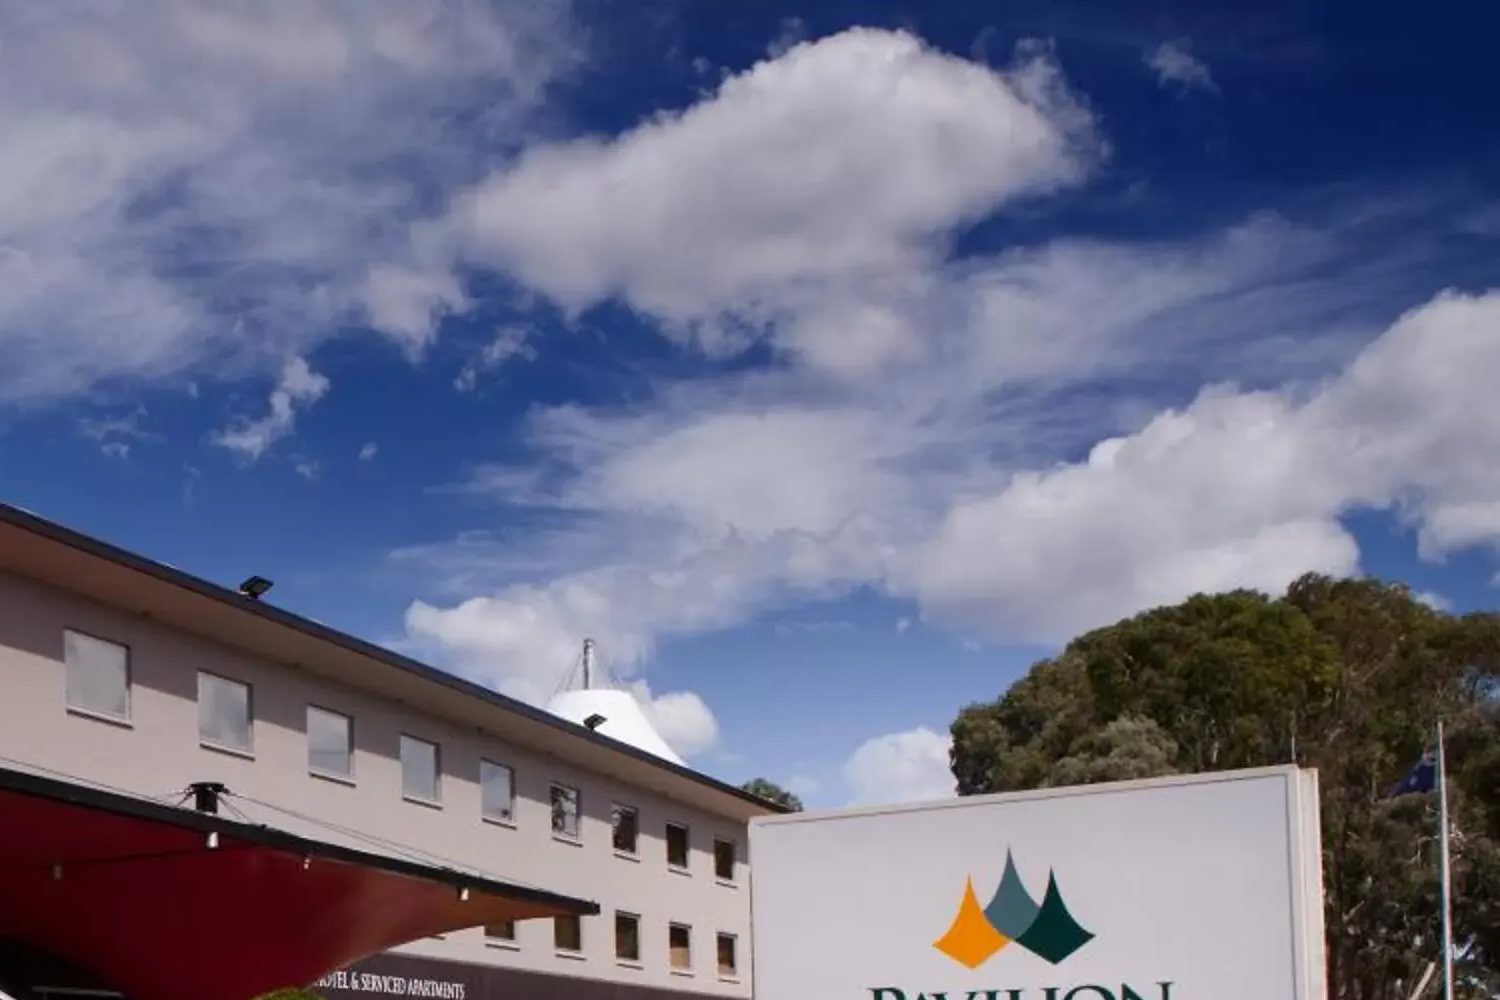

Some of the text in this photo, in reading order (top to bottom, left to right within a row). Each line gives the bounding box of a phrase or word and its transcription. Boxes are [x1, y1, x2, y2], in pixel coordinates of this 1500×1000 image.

[351, 971, 359, 990] &
[361, 973, 406, 994] SERVICED
[408, 978, 465, 1000] APARTMENTS
